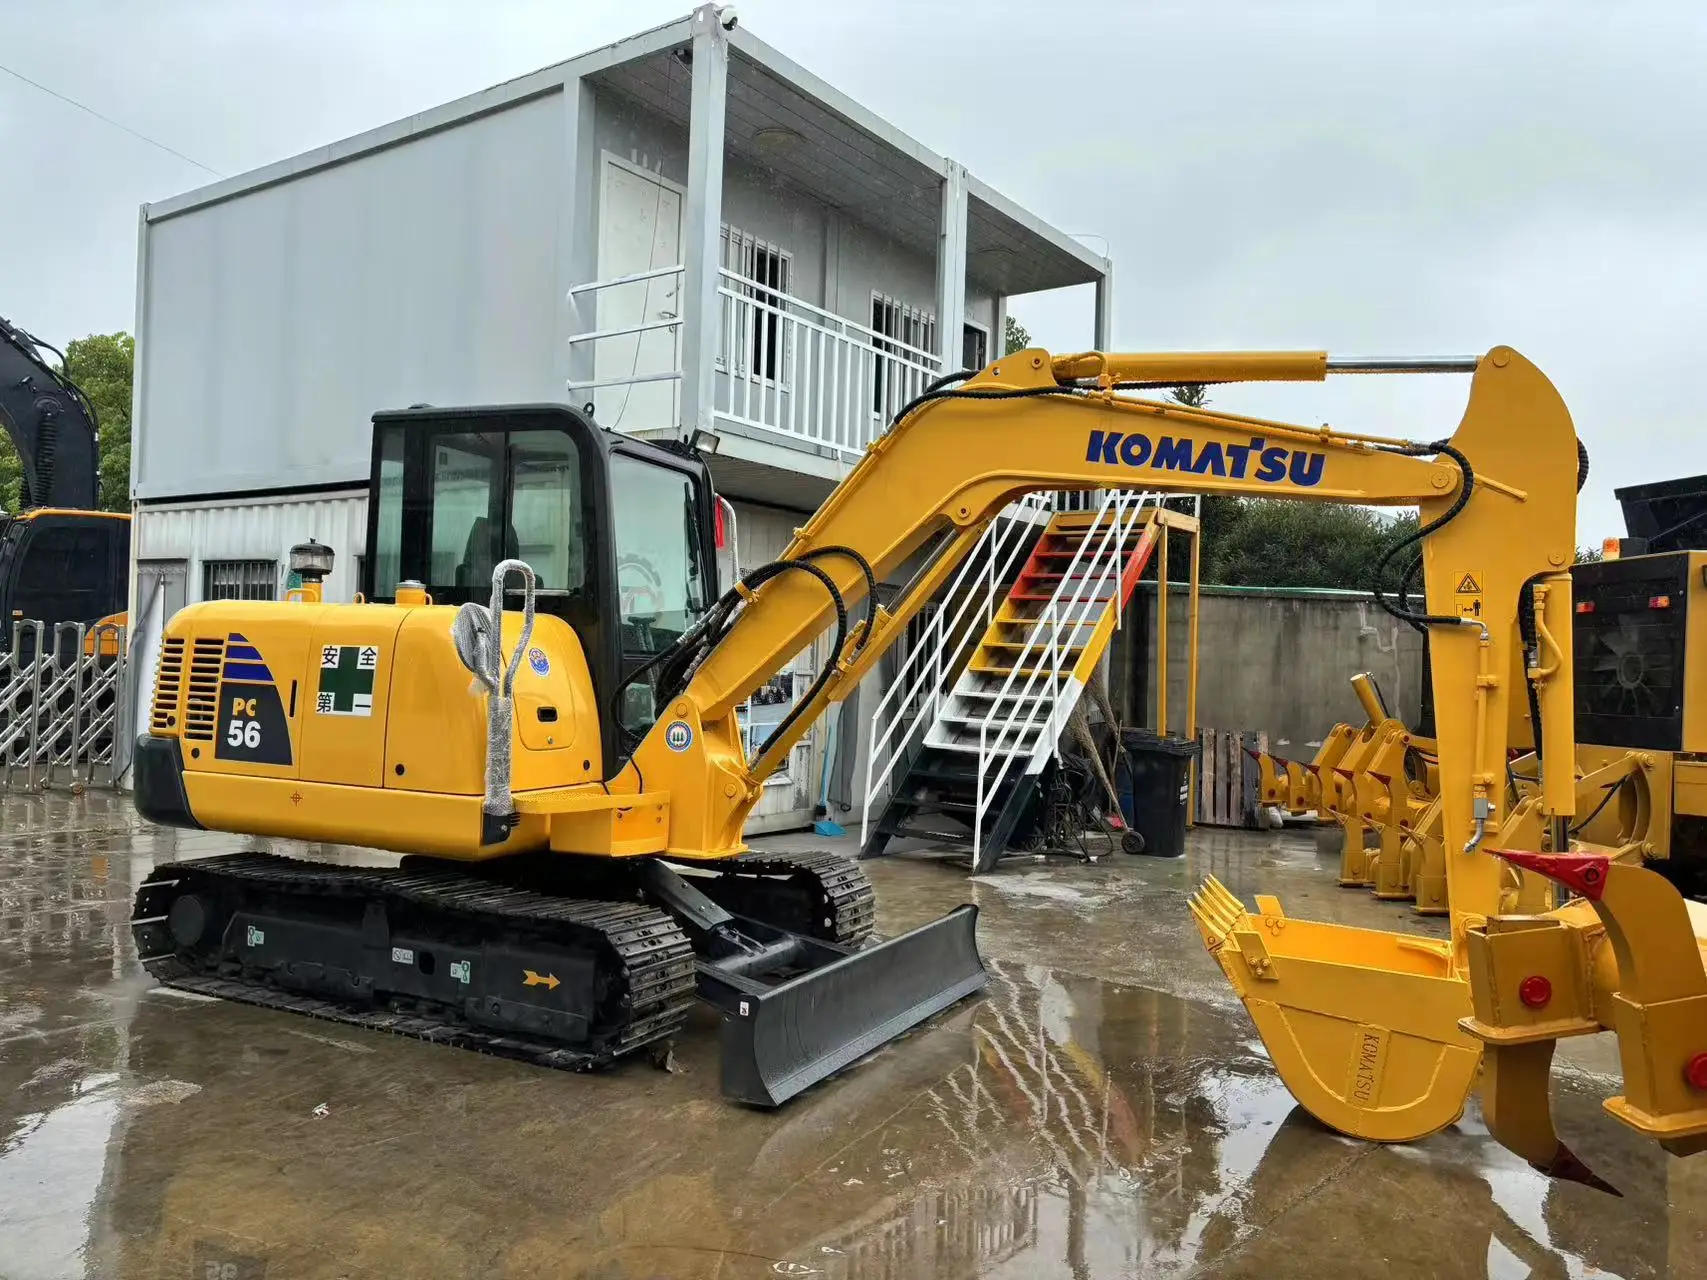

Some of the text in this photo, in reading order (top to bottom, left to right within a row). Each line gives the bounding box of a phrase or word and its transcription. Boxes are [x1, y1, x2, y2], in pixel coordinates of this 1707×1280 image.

[1086, 430, 1326, 486] KOMATSU
[232, 697, 257, 717] PC
[227, 720, 261, 748] 56
[1354, 1032, 1380, 1101] KOMATSU
